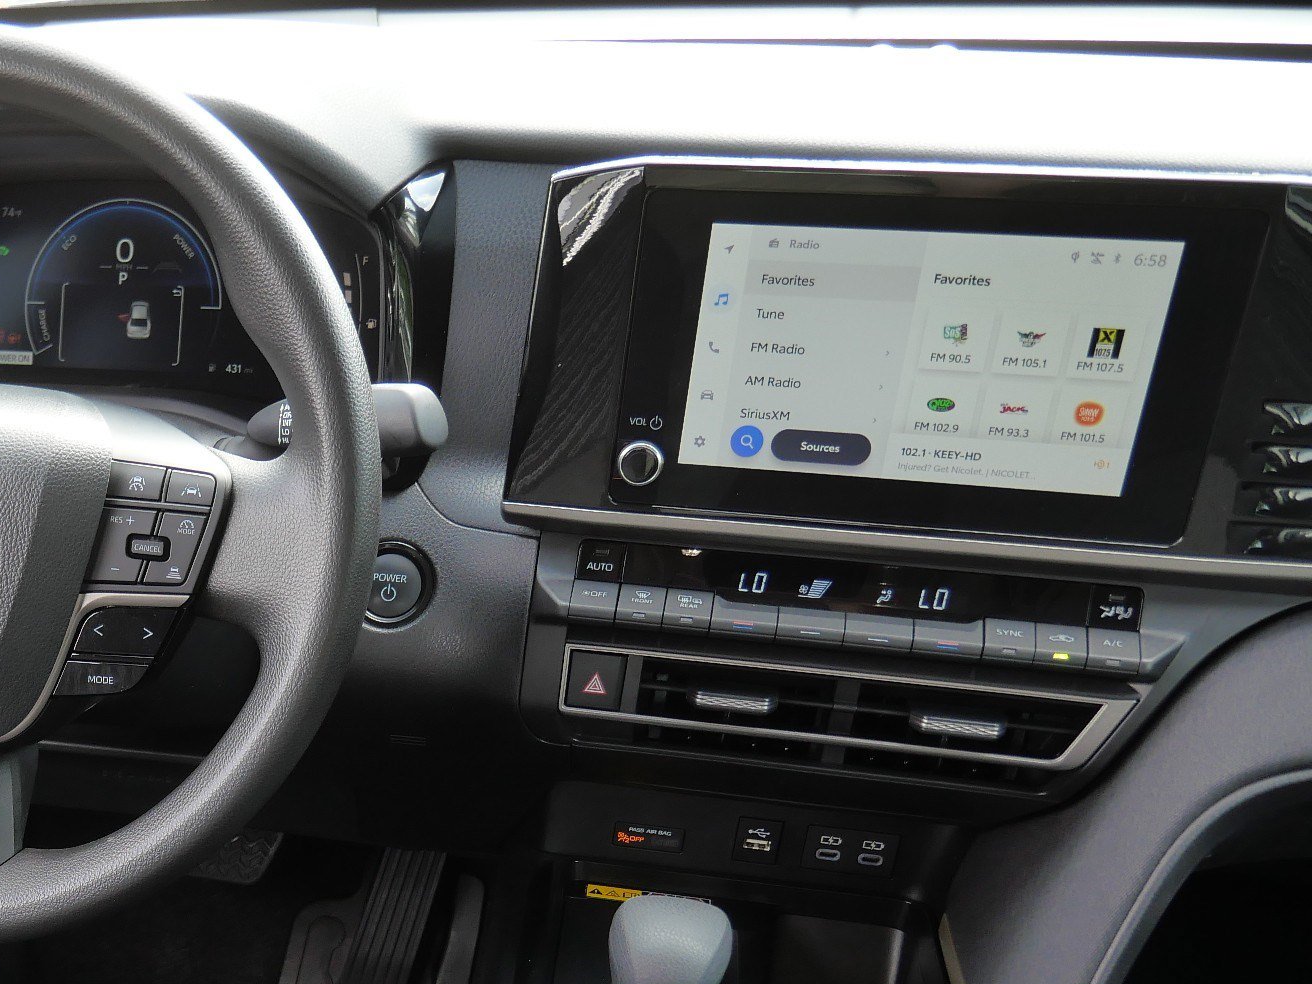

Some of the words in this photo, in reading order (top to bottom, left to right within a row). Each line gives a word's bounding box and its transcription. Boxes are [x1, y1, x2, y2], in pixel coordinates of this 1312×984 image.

[173, 233, 195, 260] POWER
[789, 240, 820, 250] Radio
[1134, 253, 1168, 268] 6:58
[118, 272, 128, 285] P
[761, 274, 816, 288] Favorites
[934, 273, 991, 287] Favorites
[756, 309, 785, 320] Tune
[750, 342, 768, 353] FM
[771, 344, 805, 355] Radio
[18, 355, 31, 364] ON
[930, 353, 946, 363] FM
[948, 354, 972, 364] 90.5
[1002, 357, 1018, 367] FM
[1021, 358, 1047, 369] 105.1
[225, 364, 242, 374] 431
[1076, 361, 1093, 371] FM
[1096, 362, 1124, 373] 107.5
[745, 376, 765, 386] AM
[768, 377, 802, 389] Radio
[740, 408, 790, 421] SiriusXM
[630, 417, 647, 426] VOL
[914, 421, 930, 431] FM
[932, 423, 959, 433] 102.9
[988, 427, 1004, 437] FM
[1007, 428, 1029, 438] 93.3
[1060, 431, 1077, 441] FM
[1080, 433, 1105, 443] 101.5
[800, 441, 840, 453] Sources
[901, 448, 926, 458] 102.1
[933, 450, 982, 461] KEEY-HD
[934, 465, 950, 473] Get
[110, 515, 123, 524] RES
[133, 543, 162, 553] CANCEL
[586, 562, 613, 572] AUTO
[373, 573, 407, 584] POWER
[738, 572, 768, 594] LO
[590, 590, 608, 598] OFF
[918, 588, 949, 611] LO
[631, 597, 654, 605] FRONT
[996, 628, 1025, 638] SYNC
[1103, 639, 1123, 648] A/C
[88, 675, 114, 685] MODE
